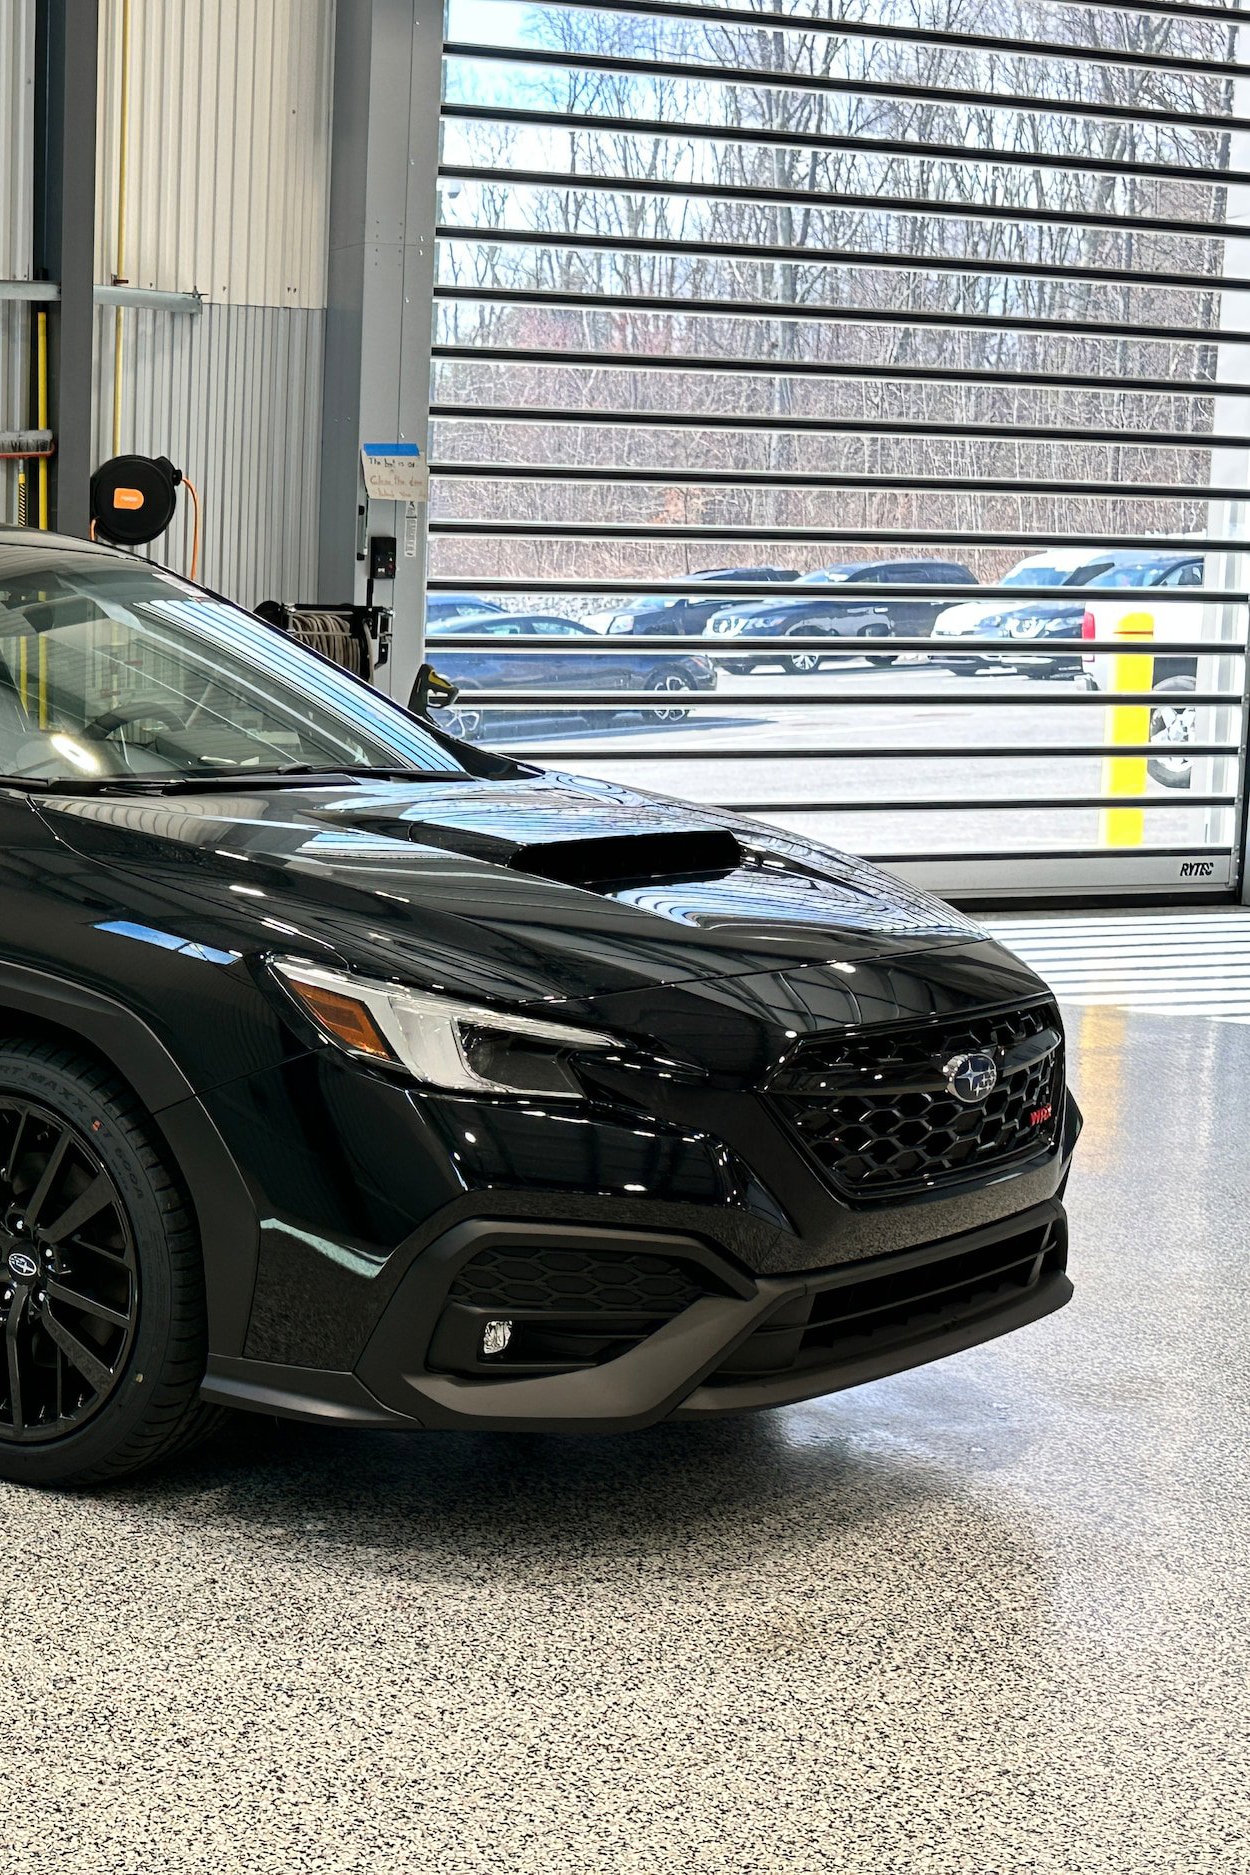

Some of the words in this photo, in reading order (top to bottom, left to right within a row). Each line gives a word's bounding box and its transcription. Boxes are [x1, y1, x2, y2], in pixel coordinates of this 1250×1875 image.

[1180, 862, 1214, 876] RYTEC
[28, 1071, 89, 1112] MAXX
[1030, 1103, 1052, 1126] WRX
